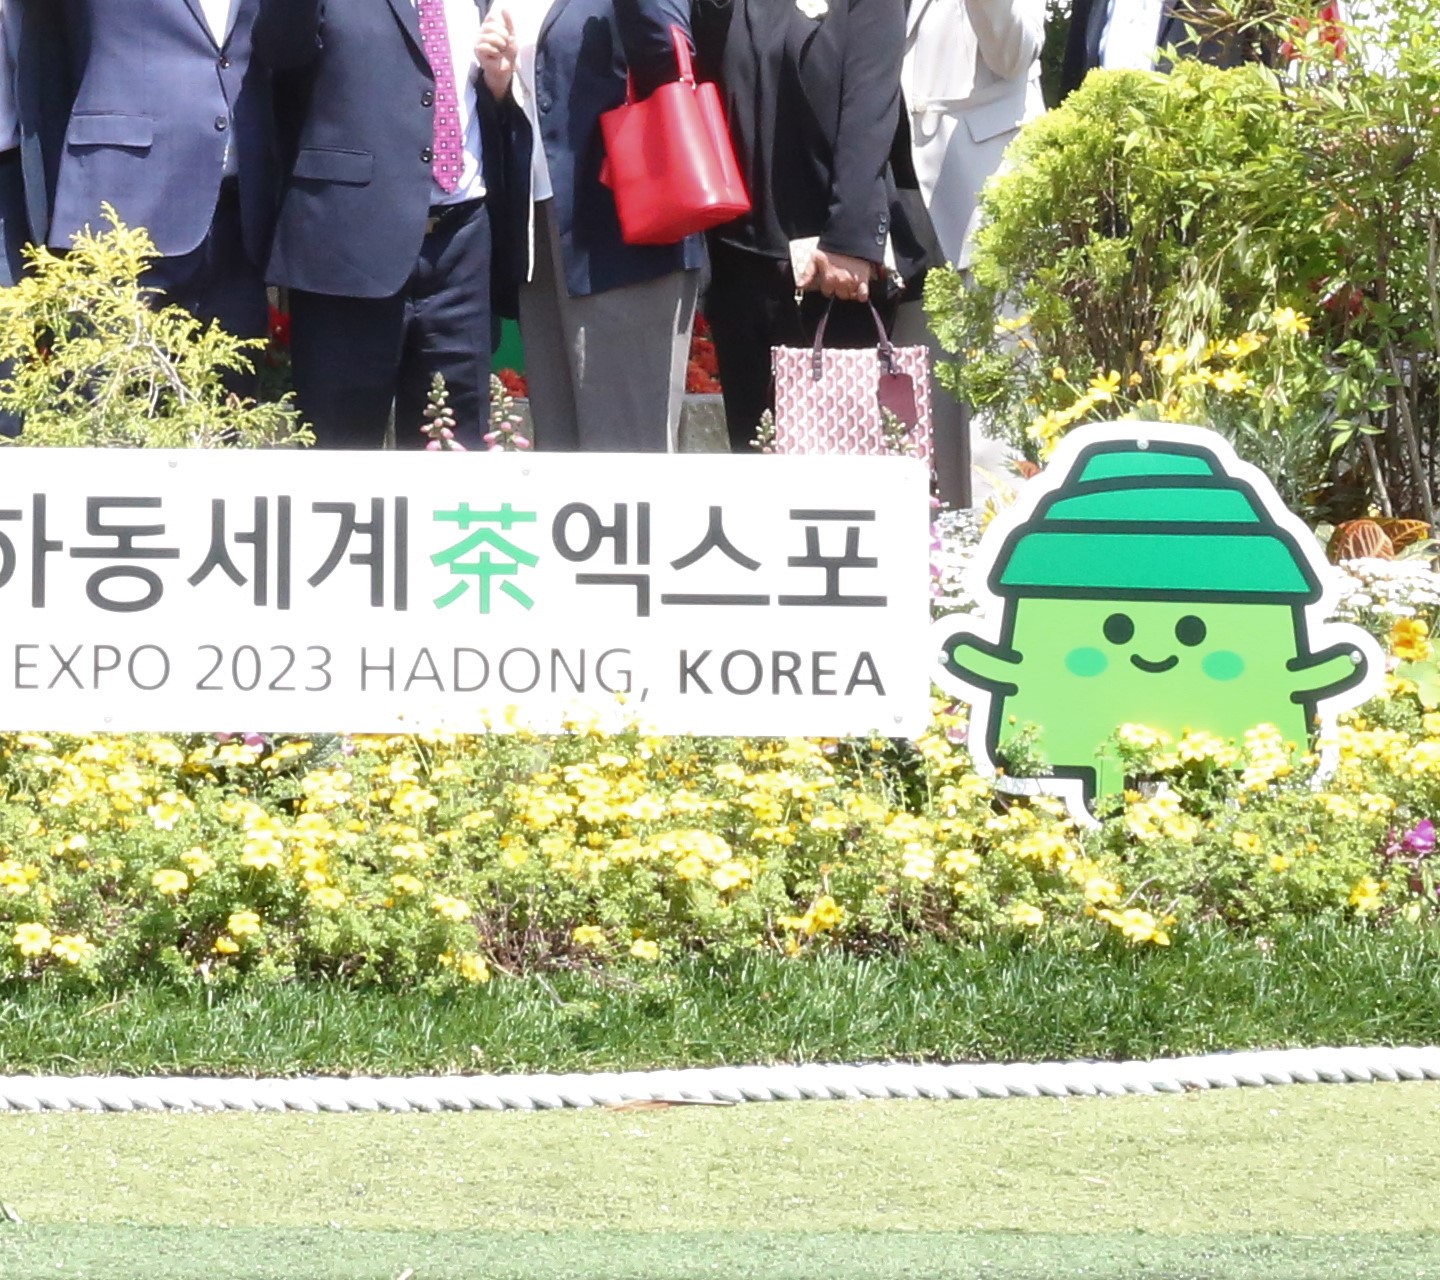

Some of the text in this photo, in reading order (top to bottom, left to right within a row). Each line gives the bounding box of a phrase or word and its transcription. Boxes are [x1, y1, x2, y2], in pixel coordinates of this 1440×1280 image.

[14, 644, 170, 691] EXPO
[196, 644, 332, 692] 2023
[361, 646, 649, 703] HADONG,
[679, 649, 887, 696] KOREA
